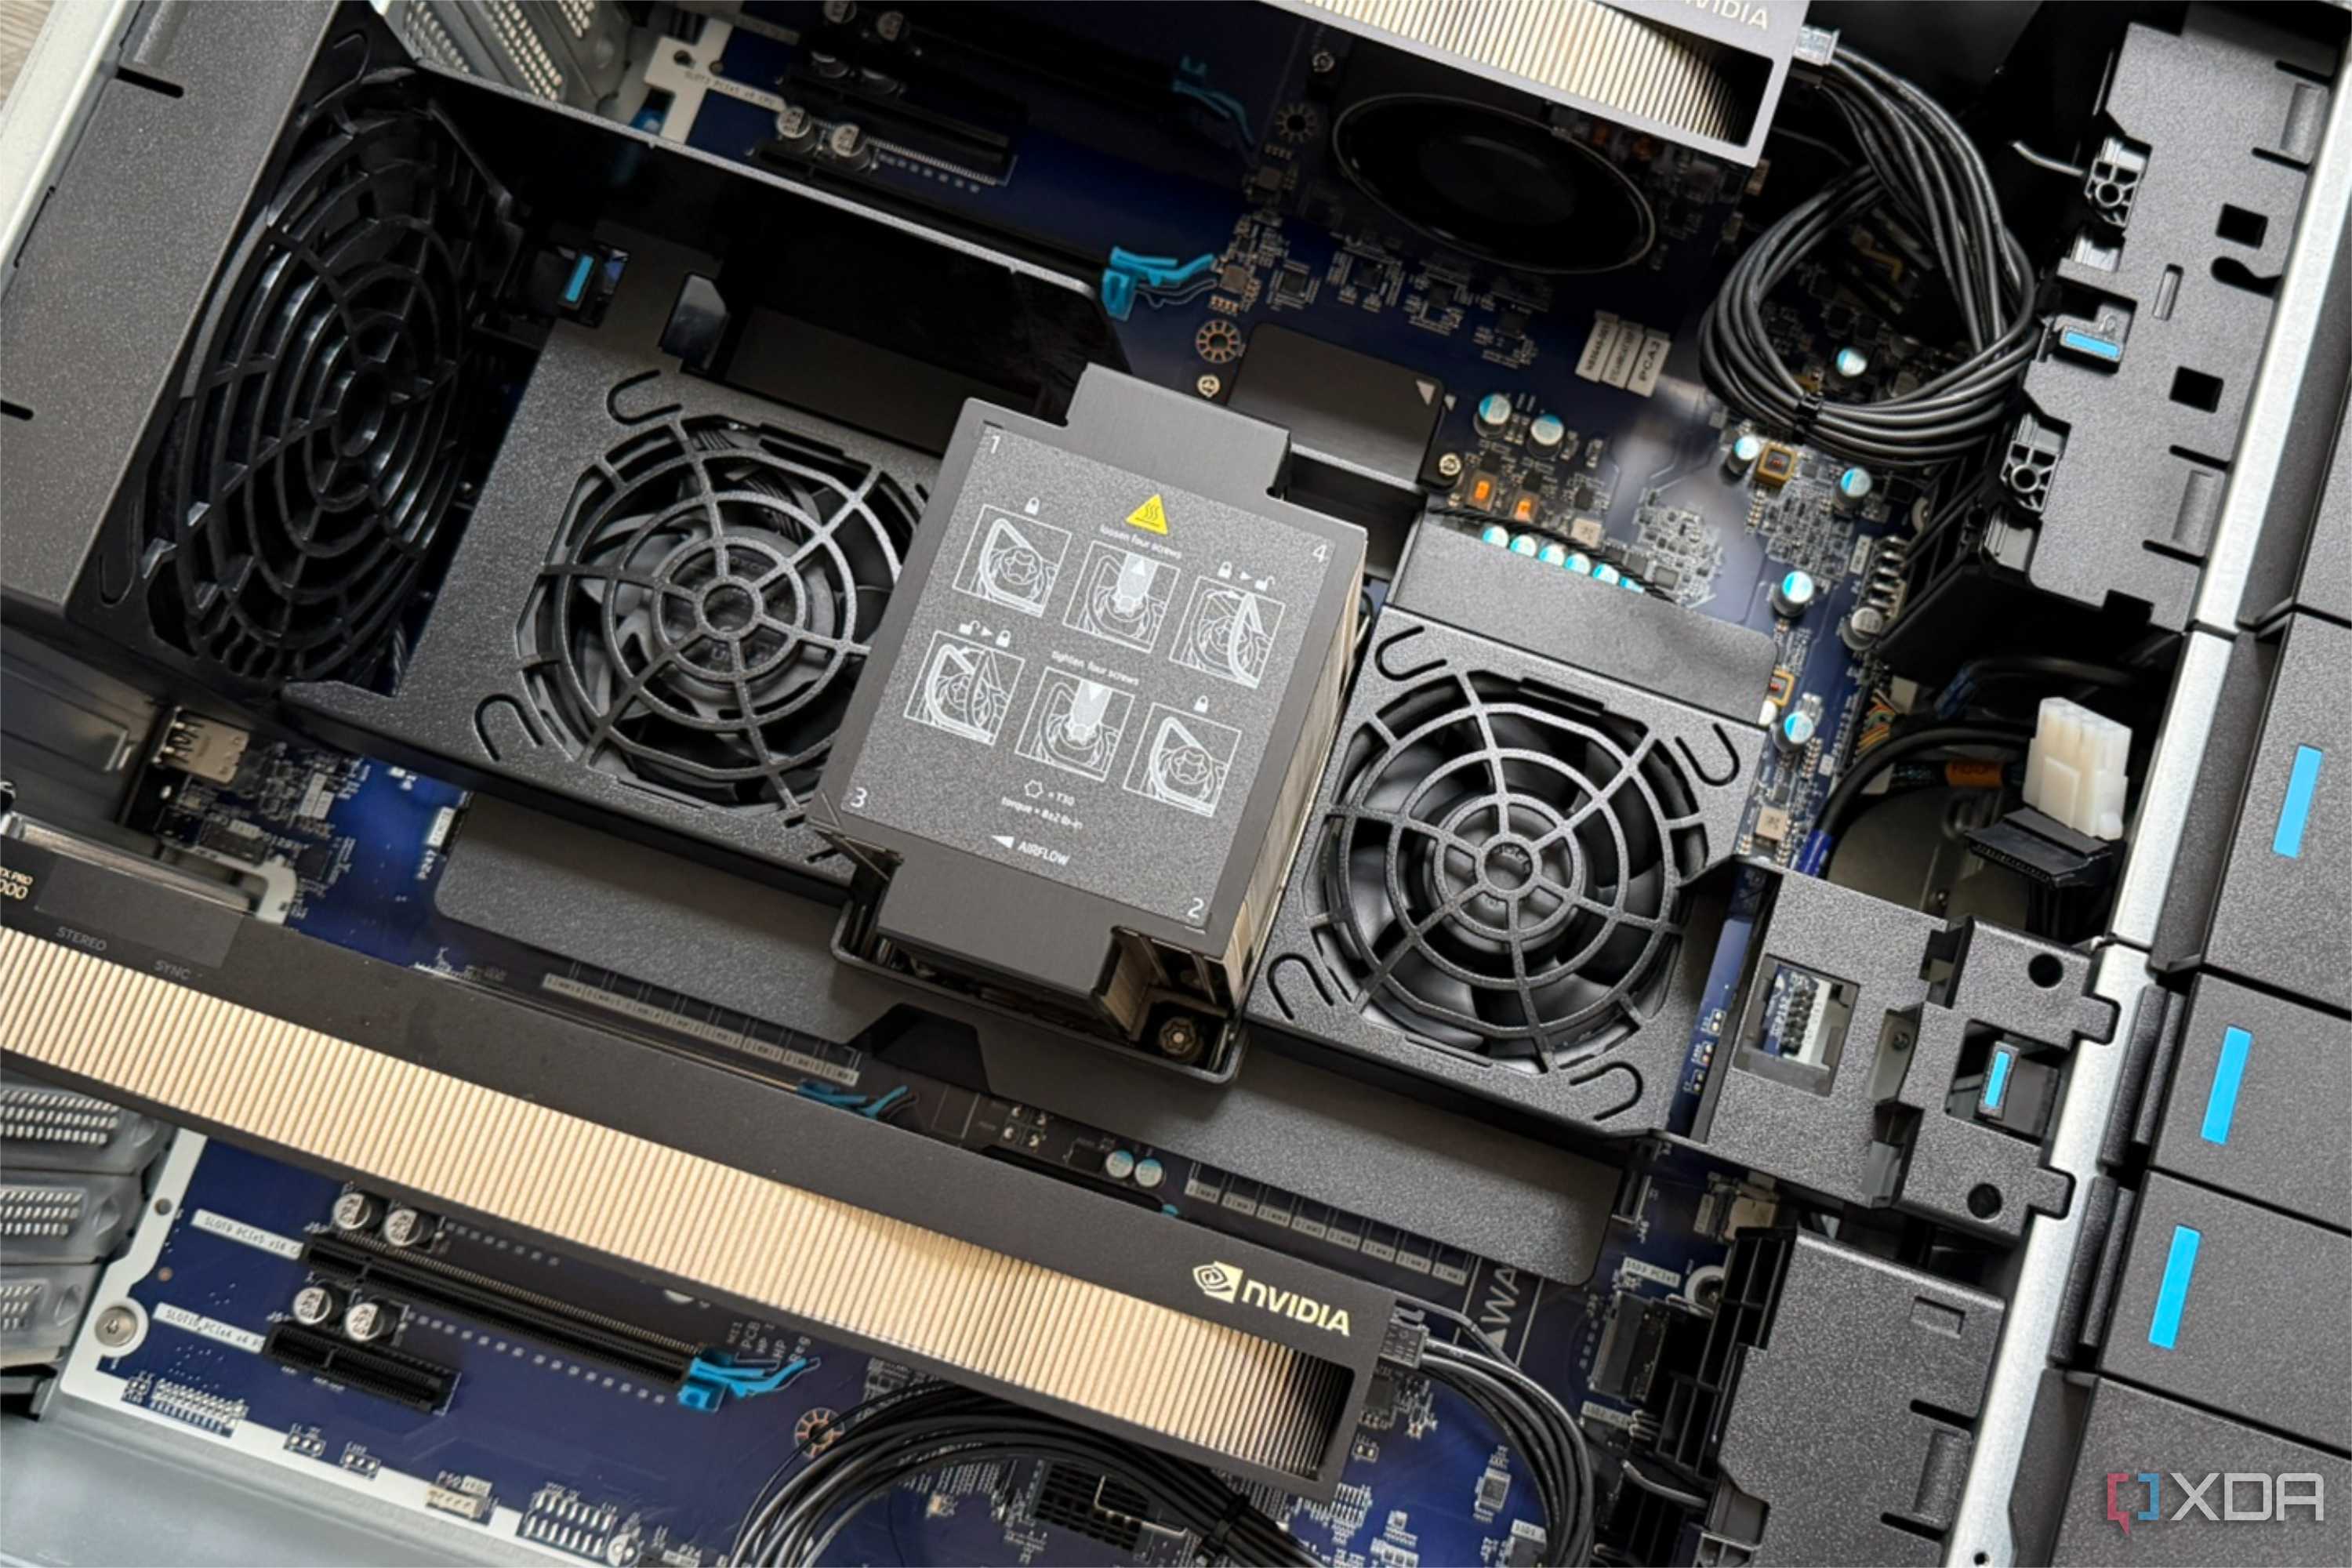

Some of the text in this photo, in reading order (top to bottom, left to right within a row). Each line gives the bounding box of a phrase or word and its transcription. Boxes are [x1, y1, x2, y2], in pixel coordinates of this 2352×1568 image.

[1684, 0, 1769, 30] IDIA
[990, 435, 1000, 454] 1
[1312, 540, 1329, 563] 4
[851, 787, 867, 808] 3
[1001, 797, 1033, 813] torque
[1018, 841, 1070, 865] AIRFLOW
[11, 871, 33, 886] PRO
[1188, 897, 1203, 918] 2
[56, 926, 107, 951] STEREO
[154, 959, 191, 980] SYNC
[1241, 1279, 1350, 1337] NVIDIA
